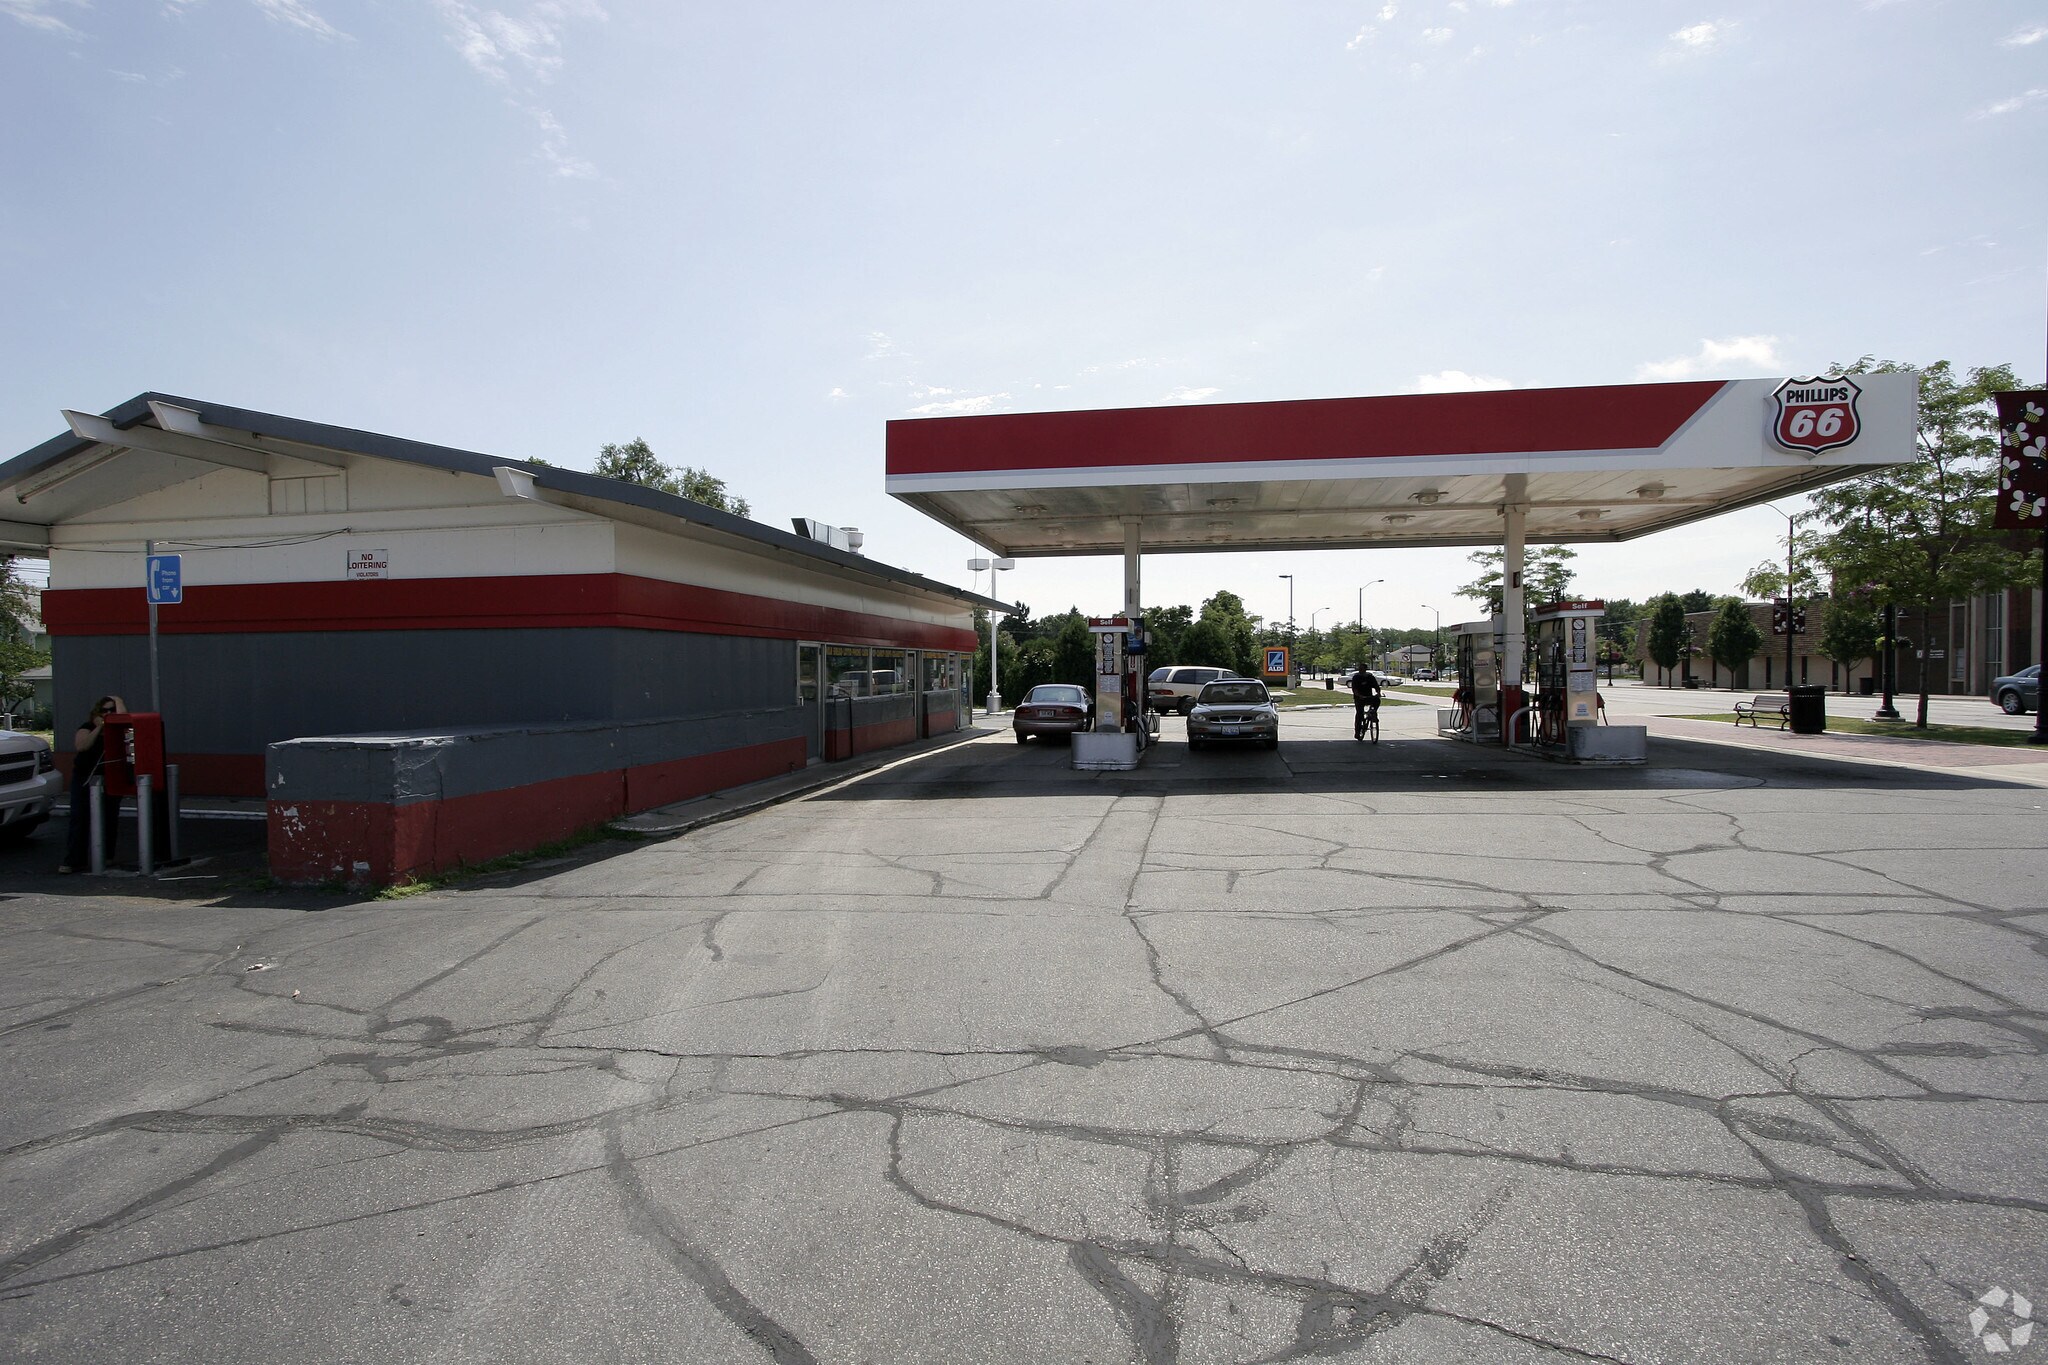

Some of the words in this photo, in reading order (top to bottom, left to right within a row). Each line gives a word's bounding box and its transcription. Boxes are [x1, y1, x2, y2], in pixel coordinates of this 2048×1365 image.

[1786, 387, 1848, 403] PHILLIPS
[1789, 408, 1844, 438] 66
[348, 561, 387, 569] LOITERING
